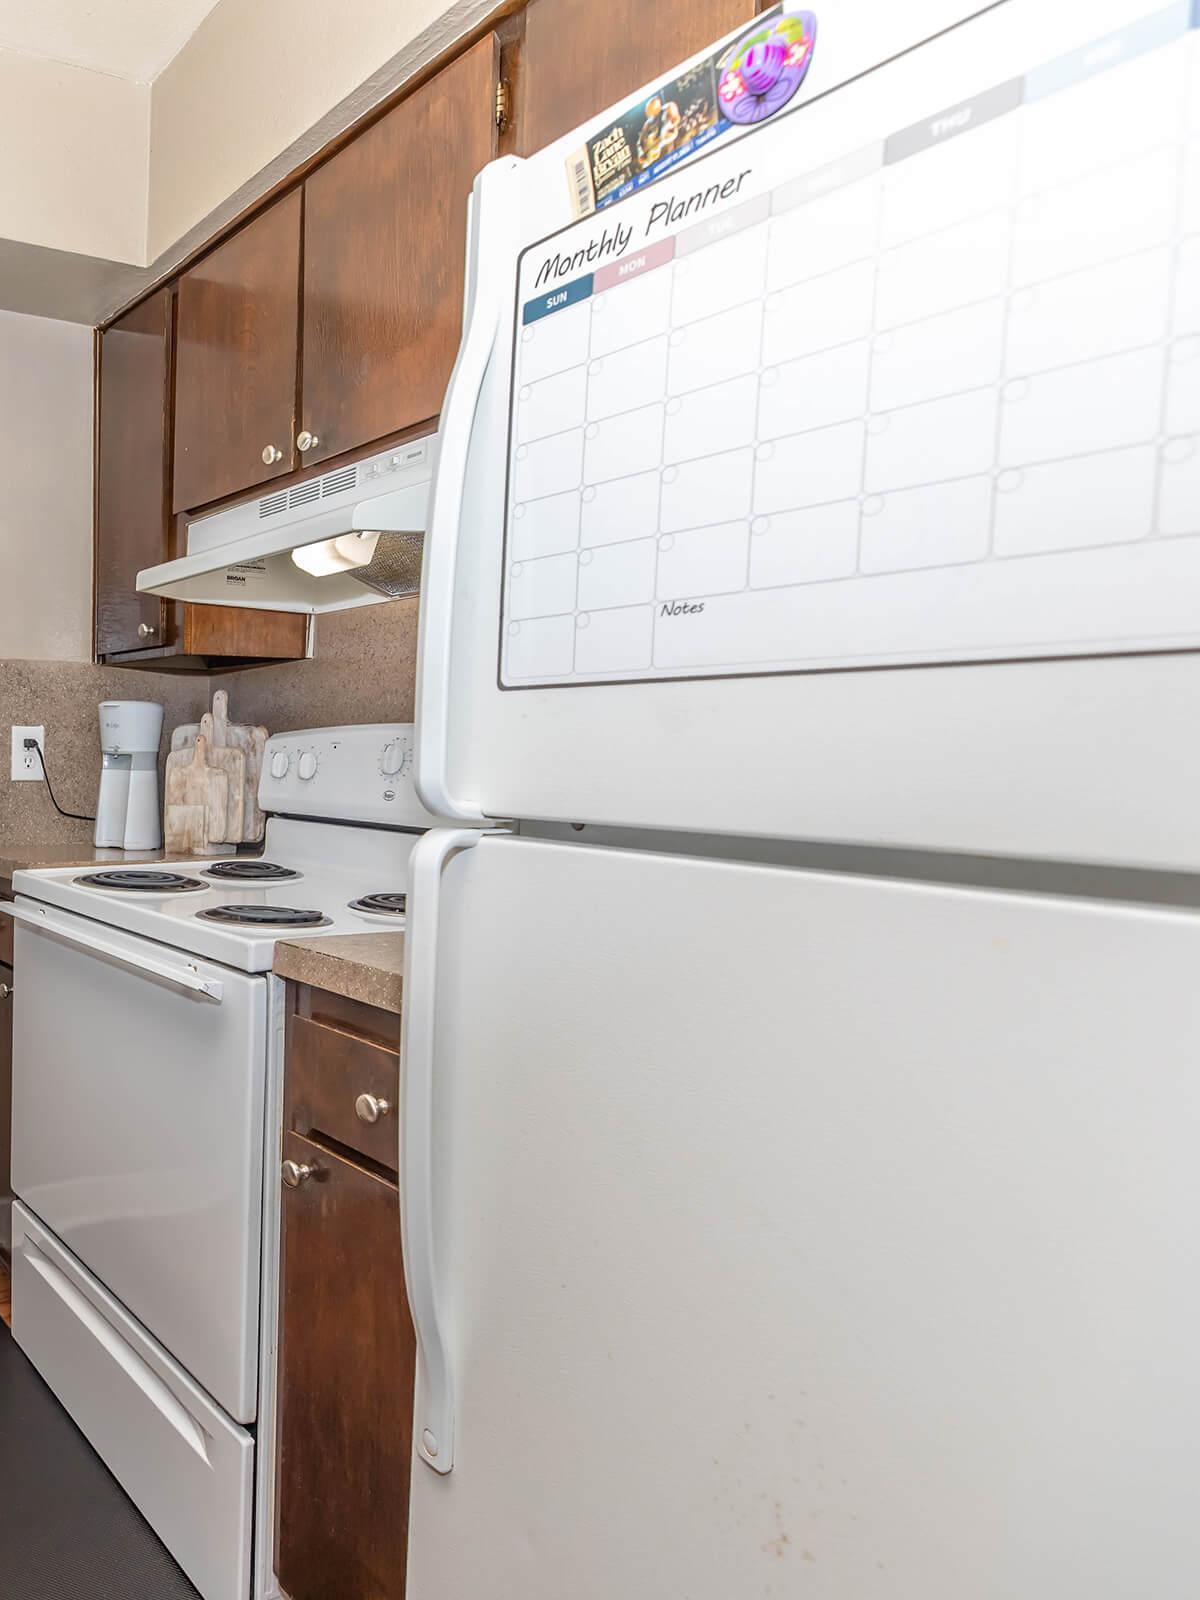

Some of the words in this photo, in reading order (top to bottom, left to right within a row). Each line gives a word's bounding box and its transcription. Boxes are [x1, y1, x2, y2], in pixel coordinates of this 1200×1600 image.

[930, 107, 971, 137] THU
[534, 222, 633, 288] Monthly
[645, 169, 752, 236] Planner
[618, 255, 647, 276] MON
[546, 291, 568, 309] SUN
[660, 600, 705, 617] Notes
